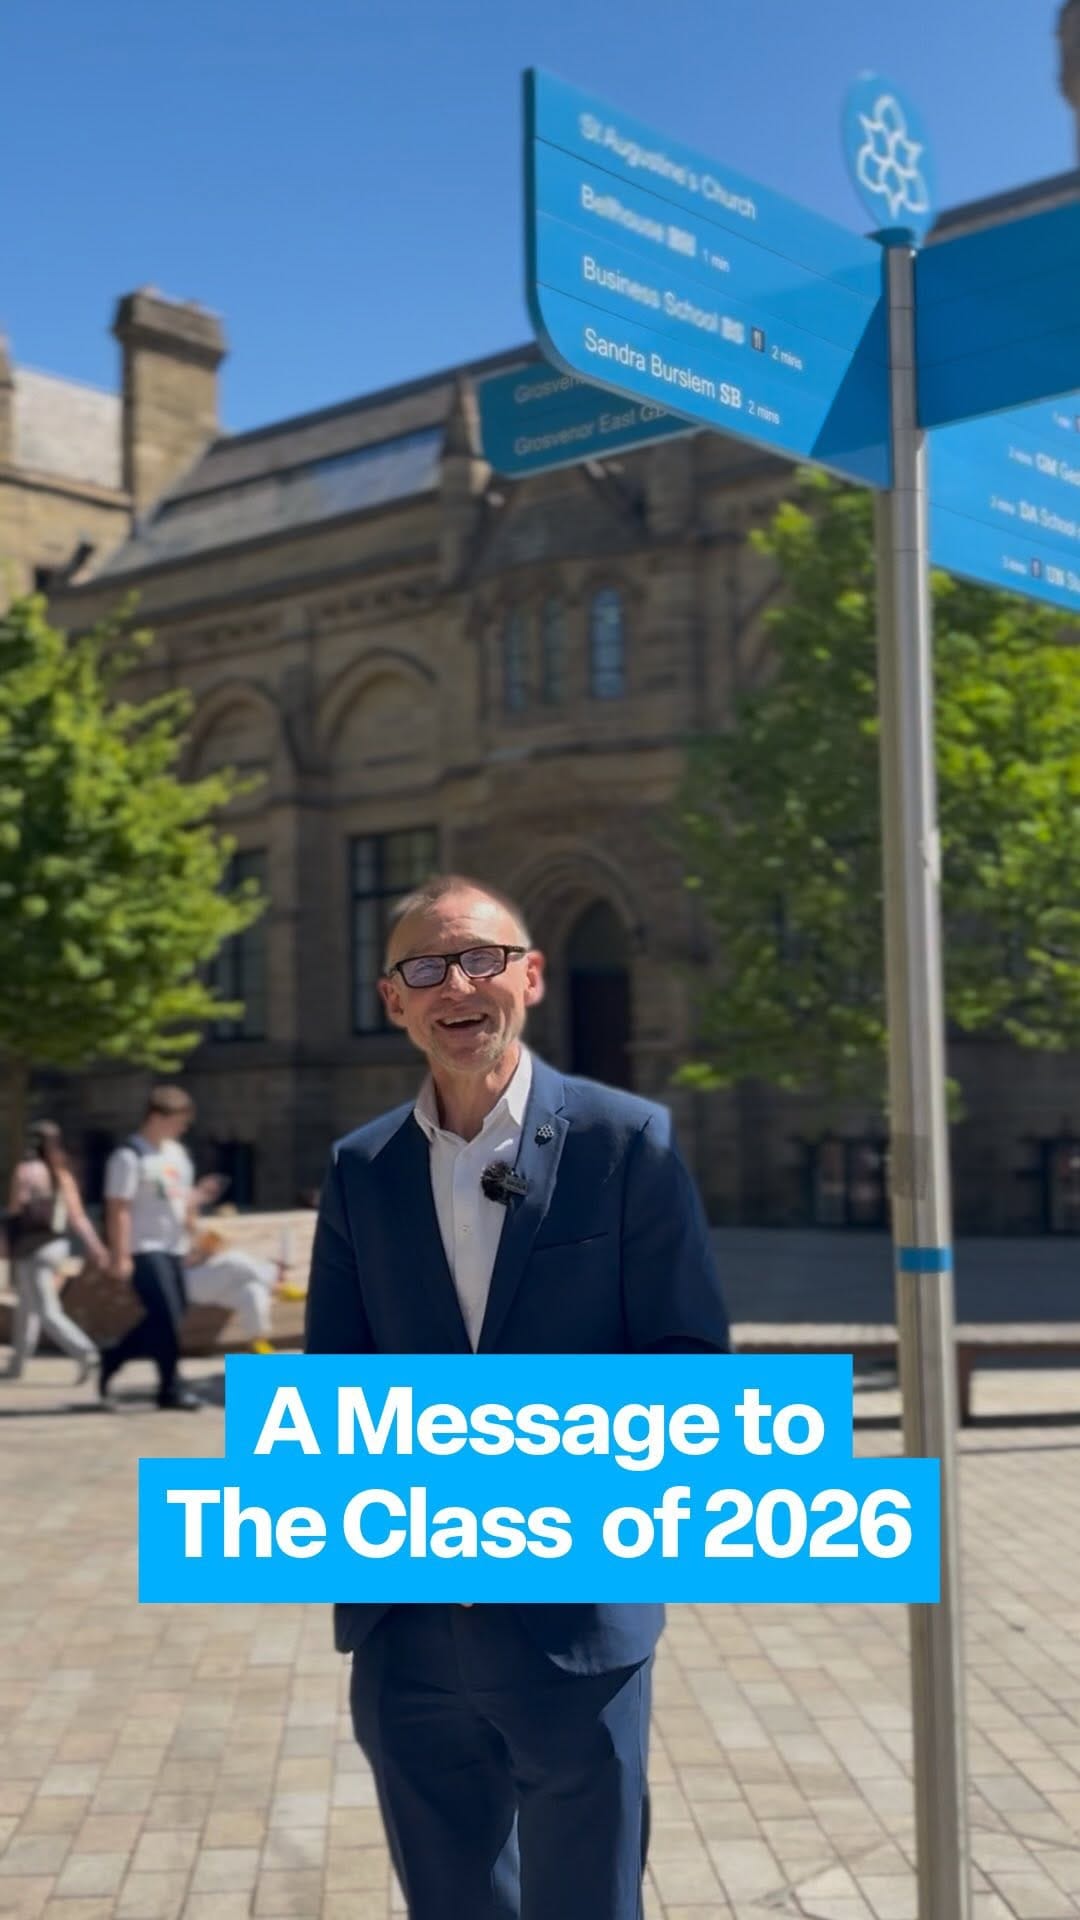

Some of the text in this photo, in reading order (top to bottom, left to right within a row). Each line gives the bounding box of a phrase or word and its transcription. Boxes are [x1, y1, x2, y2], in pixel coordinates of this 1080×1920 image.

[701, 174, 757, 221] Church
[711, 255, 731, 273] min
[583, 255, 661, 309] Business
[663, 290, 718, 333] School
[771, 344, 779, 361] 2
[780, 352, 804, 372] mins
[584, 327, 781, 426] Sandra Burslem SB 2 mins
[599, 410, 637, 434] East
